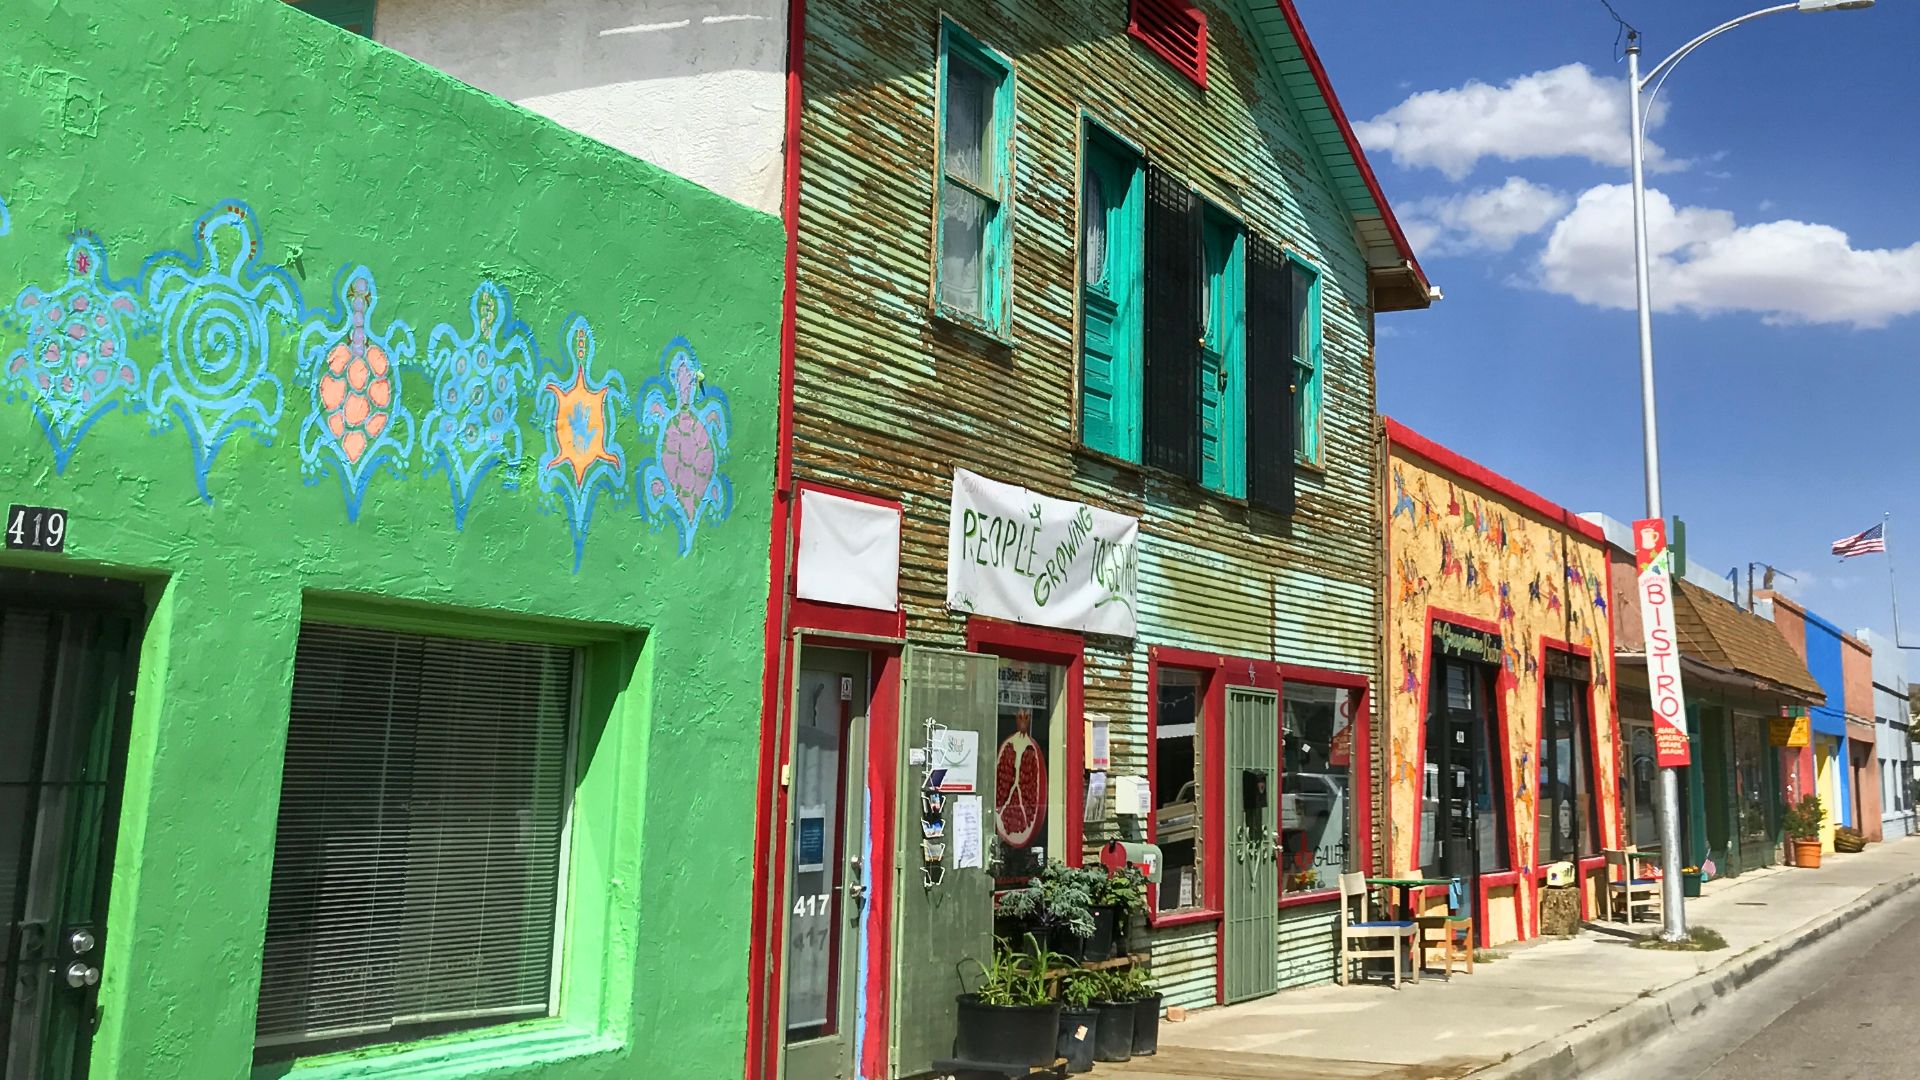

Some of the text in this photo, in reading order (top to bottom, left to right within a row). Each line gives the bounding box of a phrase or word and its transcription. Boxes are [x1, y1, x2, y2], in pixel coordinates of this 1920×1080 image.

[9, 511, 64, 547] 419
[963, 508, 1041, 577] PEOPLE
[1034, 505, 1093, 606] GROWING
[1091, 536, 1137, 596] TOGETHER
[1647, 583, 1679, 717] BISTRO
[793, 894, 829, 917] 417
